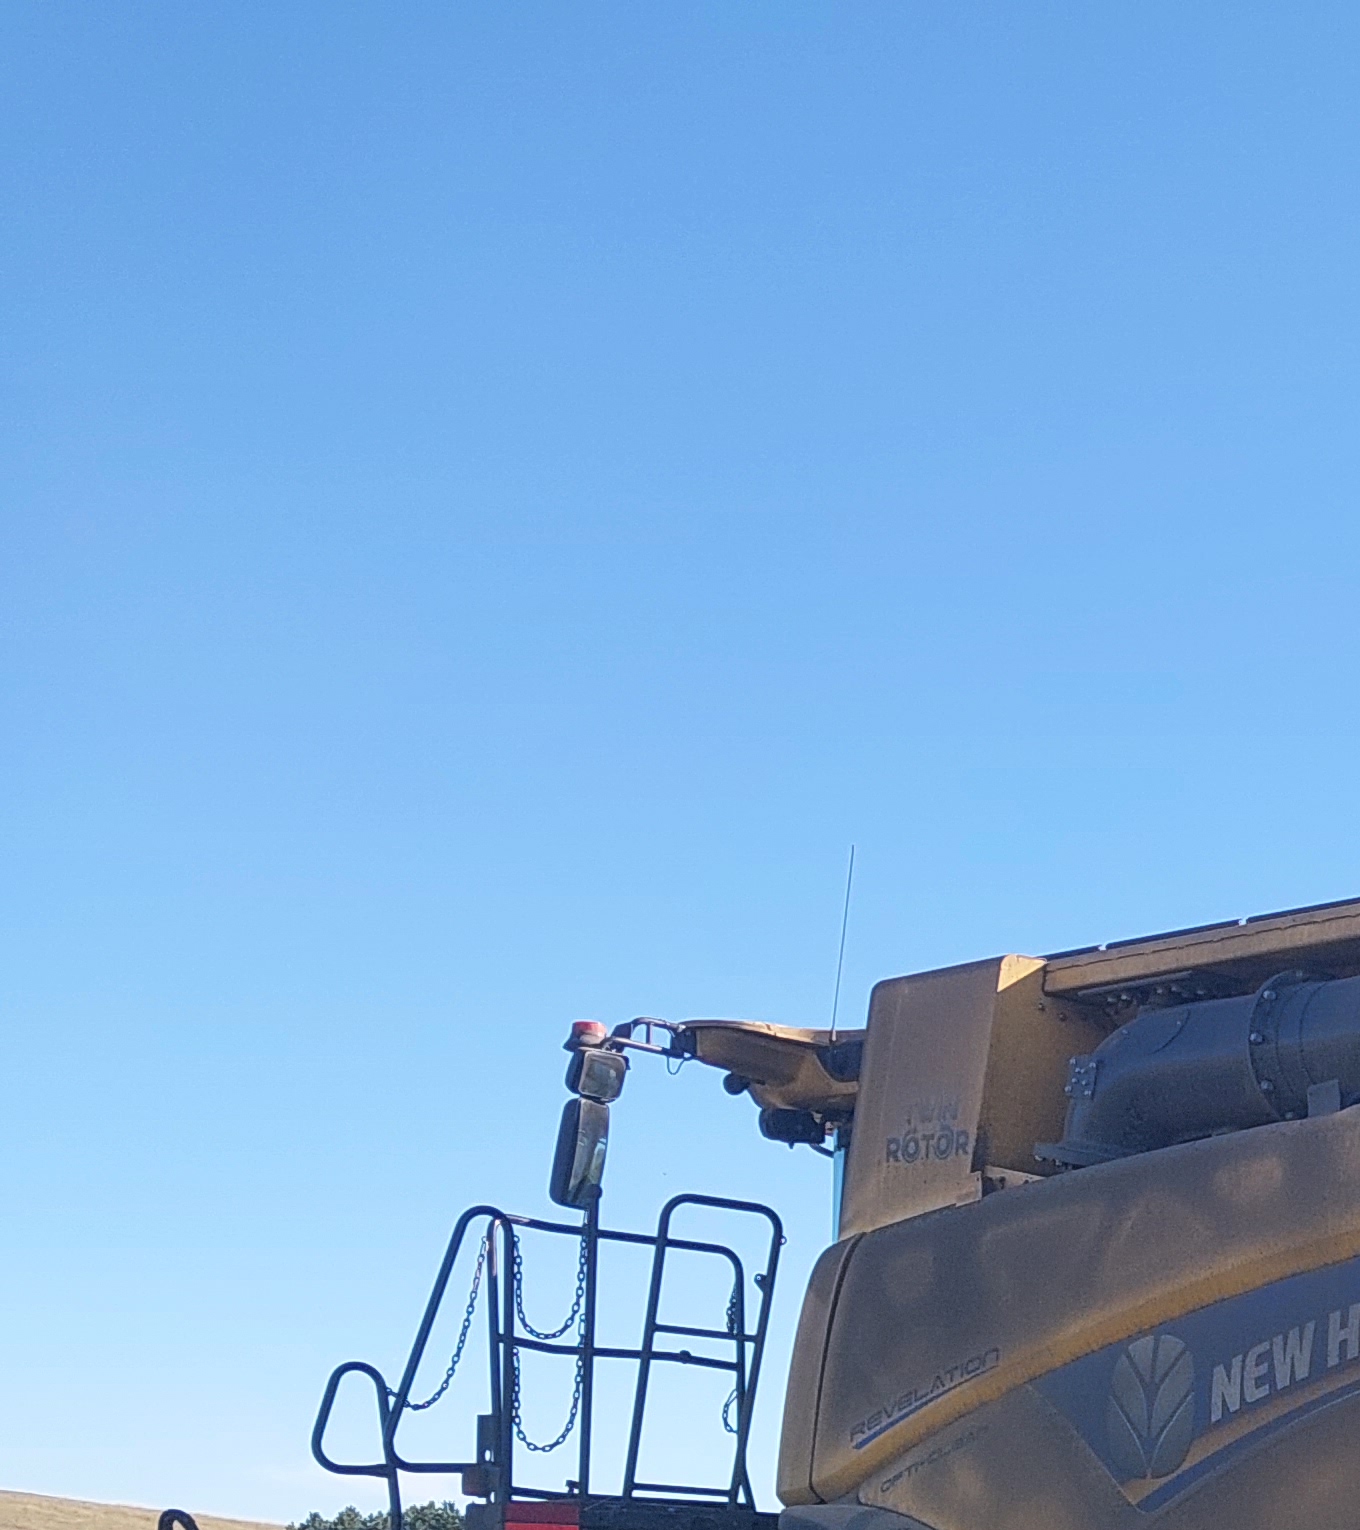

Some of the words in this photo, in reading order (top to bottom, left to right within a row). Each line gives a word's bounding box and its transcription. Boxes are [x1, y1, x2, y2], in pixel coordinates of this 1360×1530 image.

[886, 1124, 970, 1164] ROTOR
[850, 1347, 1000, 1442] REVELATION
[1210, 1320, 1317, 1423] NEW
